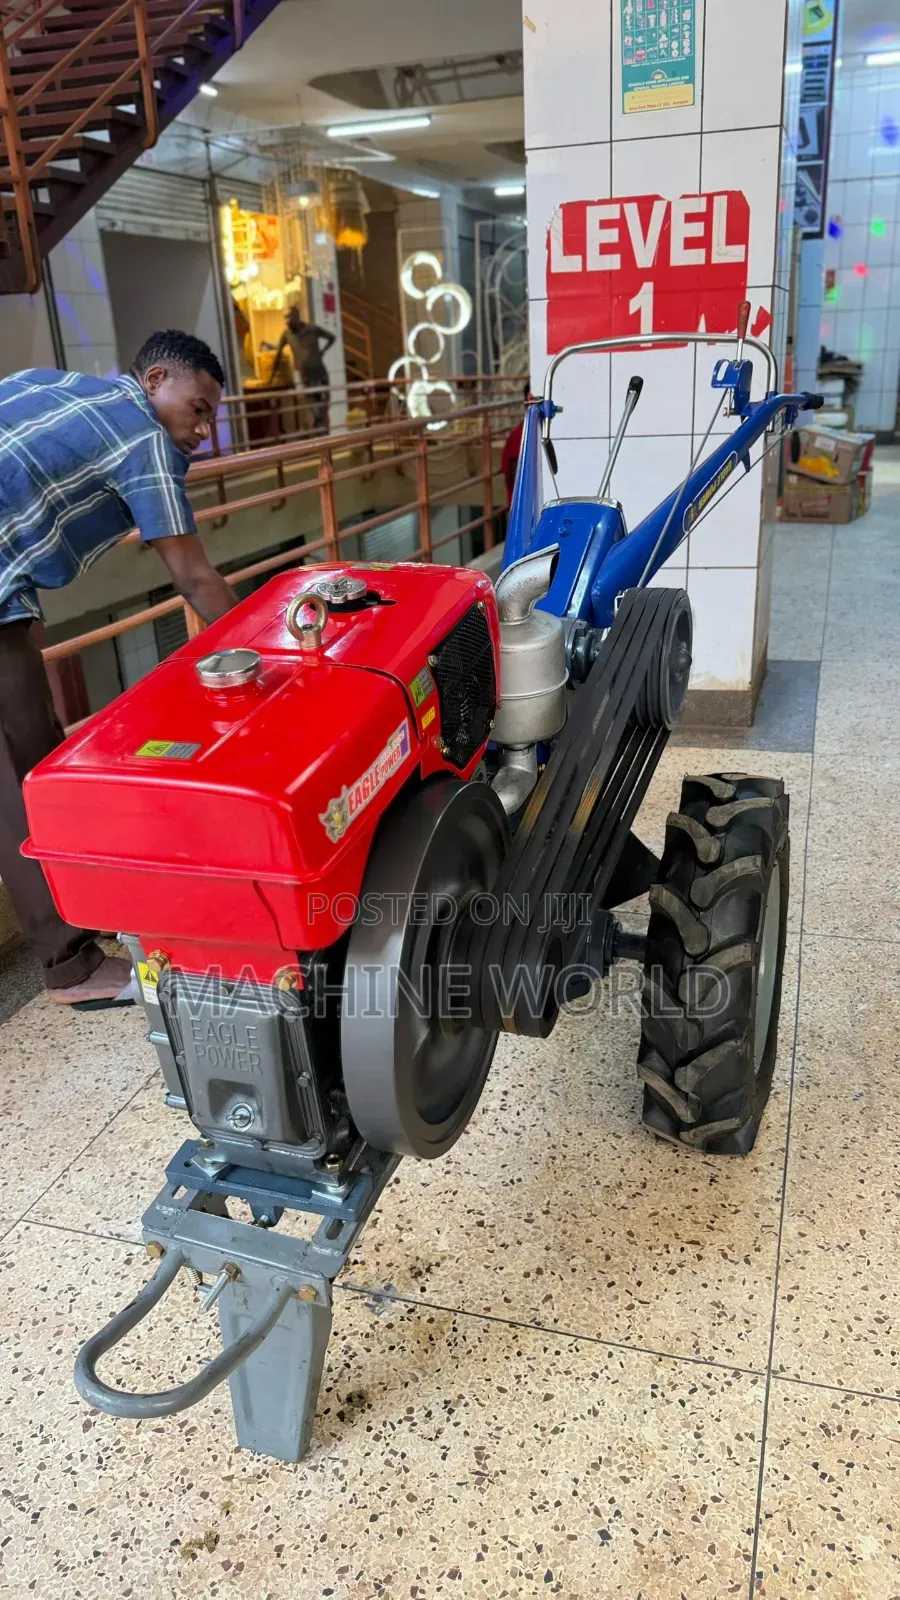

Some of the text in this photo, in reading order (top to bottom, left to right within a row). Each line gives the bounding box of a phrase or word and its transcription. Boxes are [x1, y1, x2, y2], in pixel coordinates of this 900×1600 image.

[551, 195, 746, 273] LEVEL
[629, 281, 654, 346] 1
[348, 764, 381, 816] EAGLE
[380, 746, 401, 778] POWER
[190, 1017, 260, 1050] EAGLE
[194, 1041, 264, 1075] POWER
